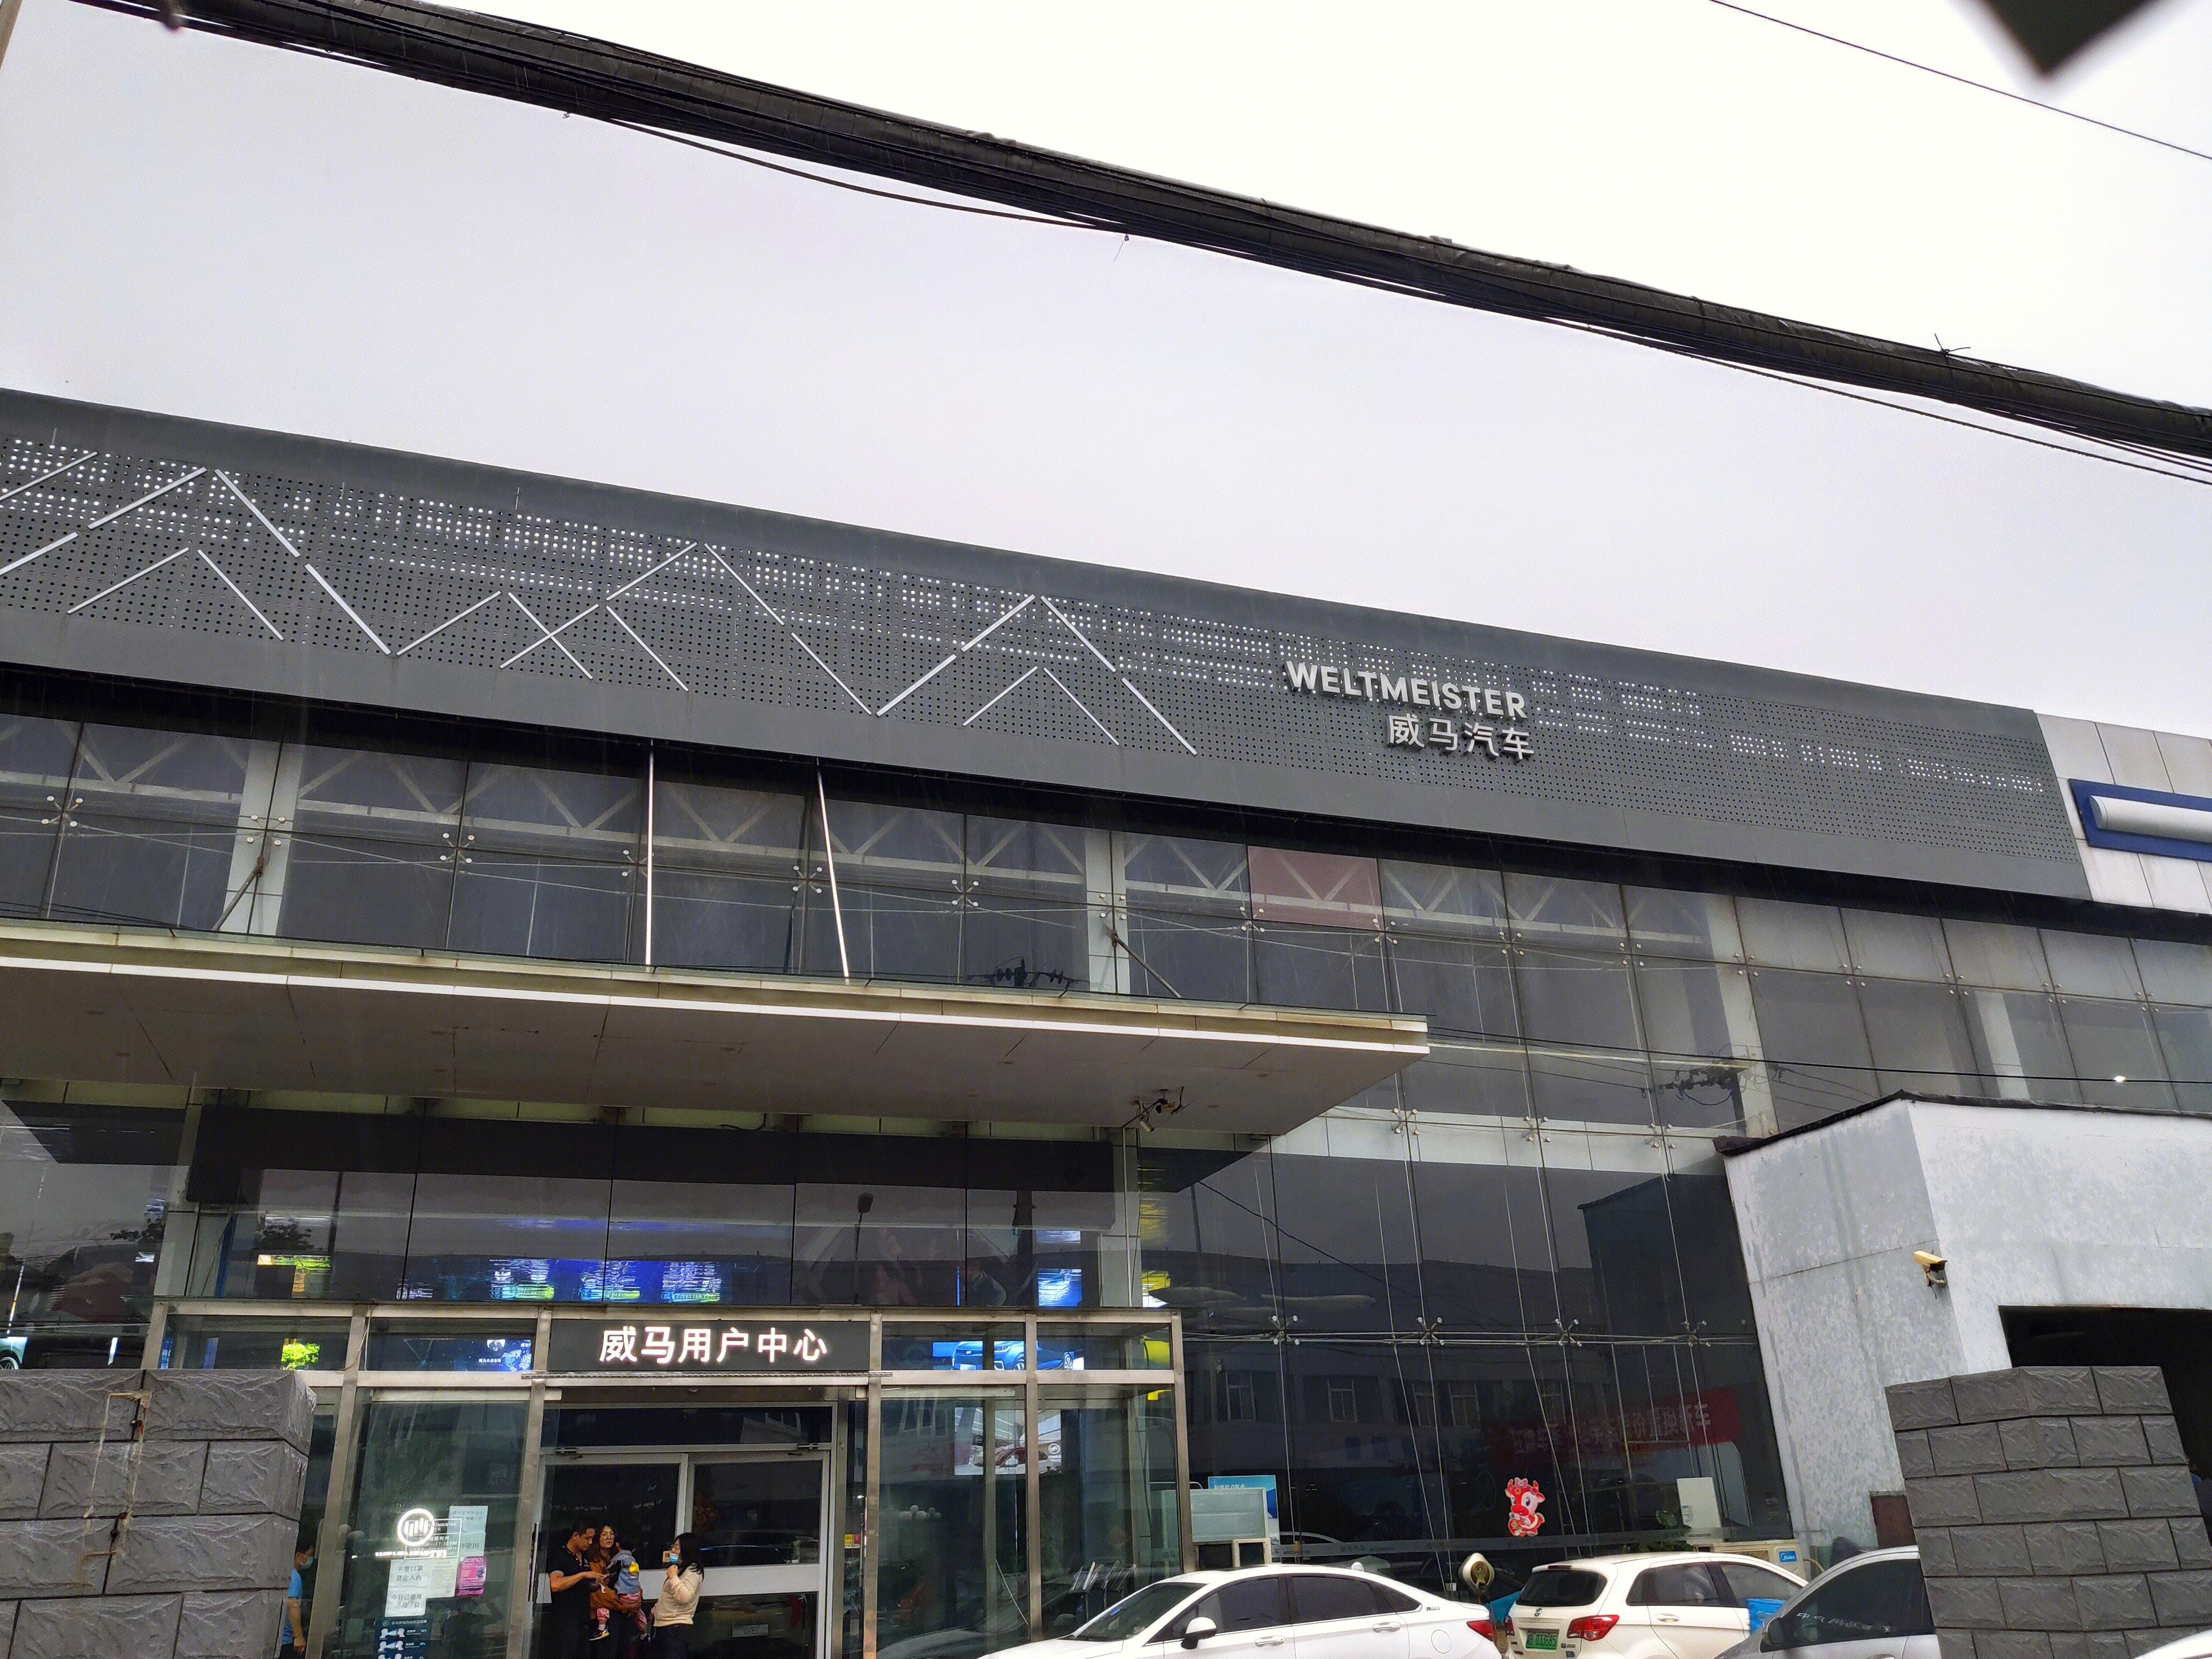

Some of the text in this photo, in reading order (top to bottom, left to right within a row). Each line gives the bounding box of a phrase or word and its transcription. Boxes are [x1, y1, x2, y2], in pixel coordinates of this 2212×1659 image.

[1286, 660, 1527, 720] WELTMEISTER
[1386, 713, 1535, 761] 威马汽车
[599, 1325, 828, 1364] 威马用户中心
